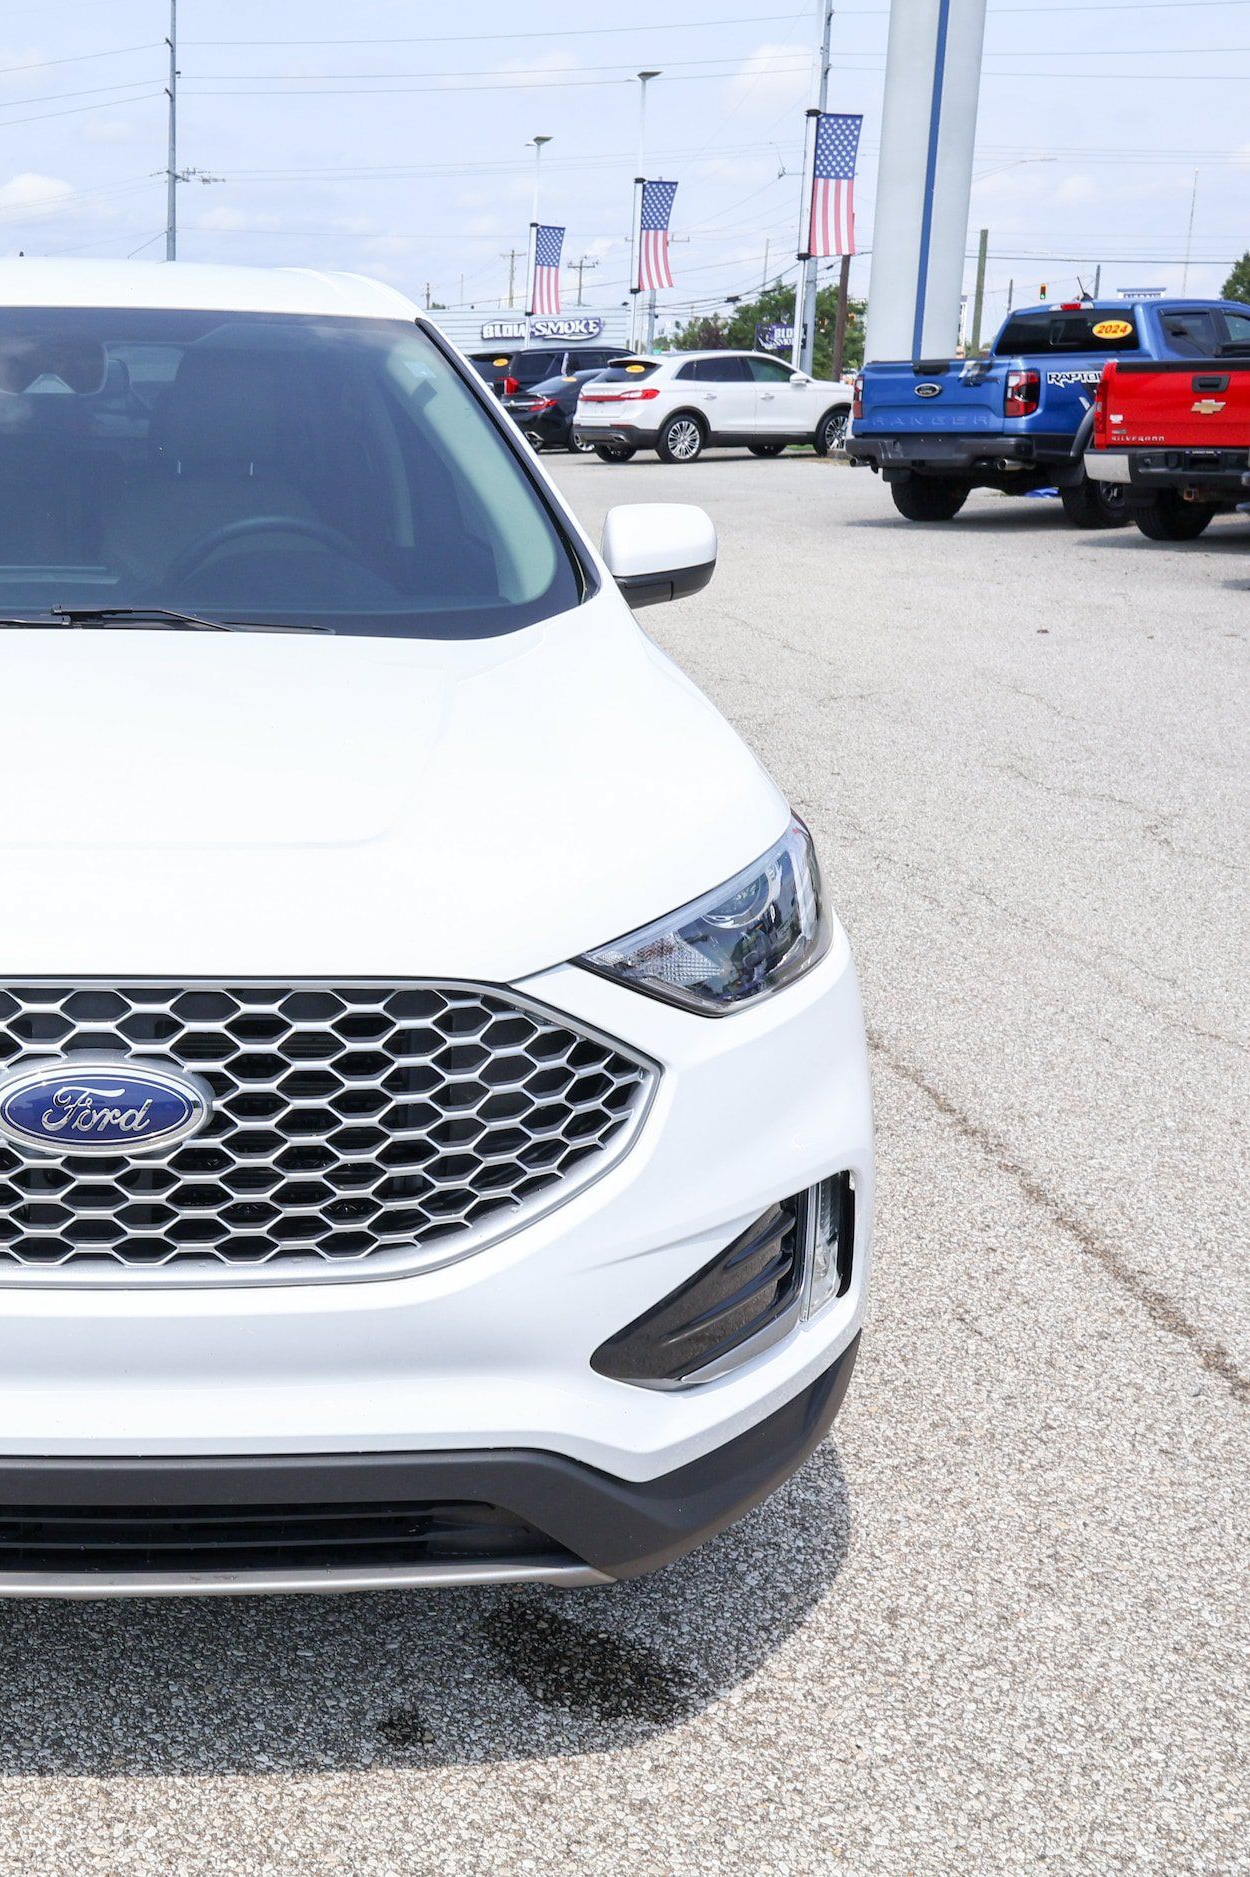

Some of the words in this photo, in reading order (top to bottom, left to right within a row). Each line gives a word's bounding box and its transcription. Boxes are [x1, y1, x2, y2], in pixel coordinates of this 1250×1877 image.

[534, 319, 600, 337] SMOKE
[1096, 324, 1128, 334] 2024
[872, 415, 989, 427] RANGER
[41, 1086, 153, 1132] Ford
